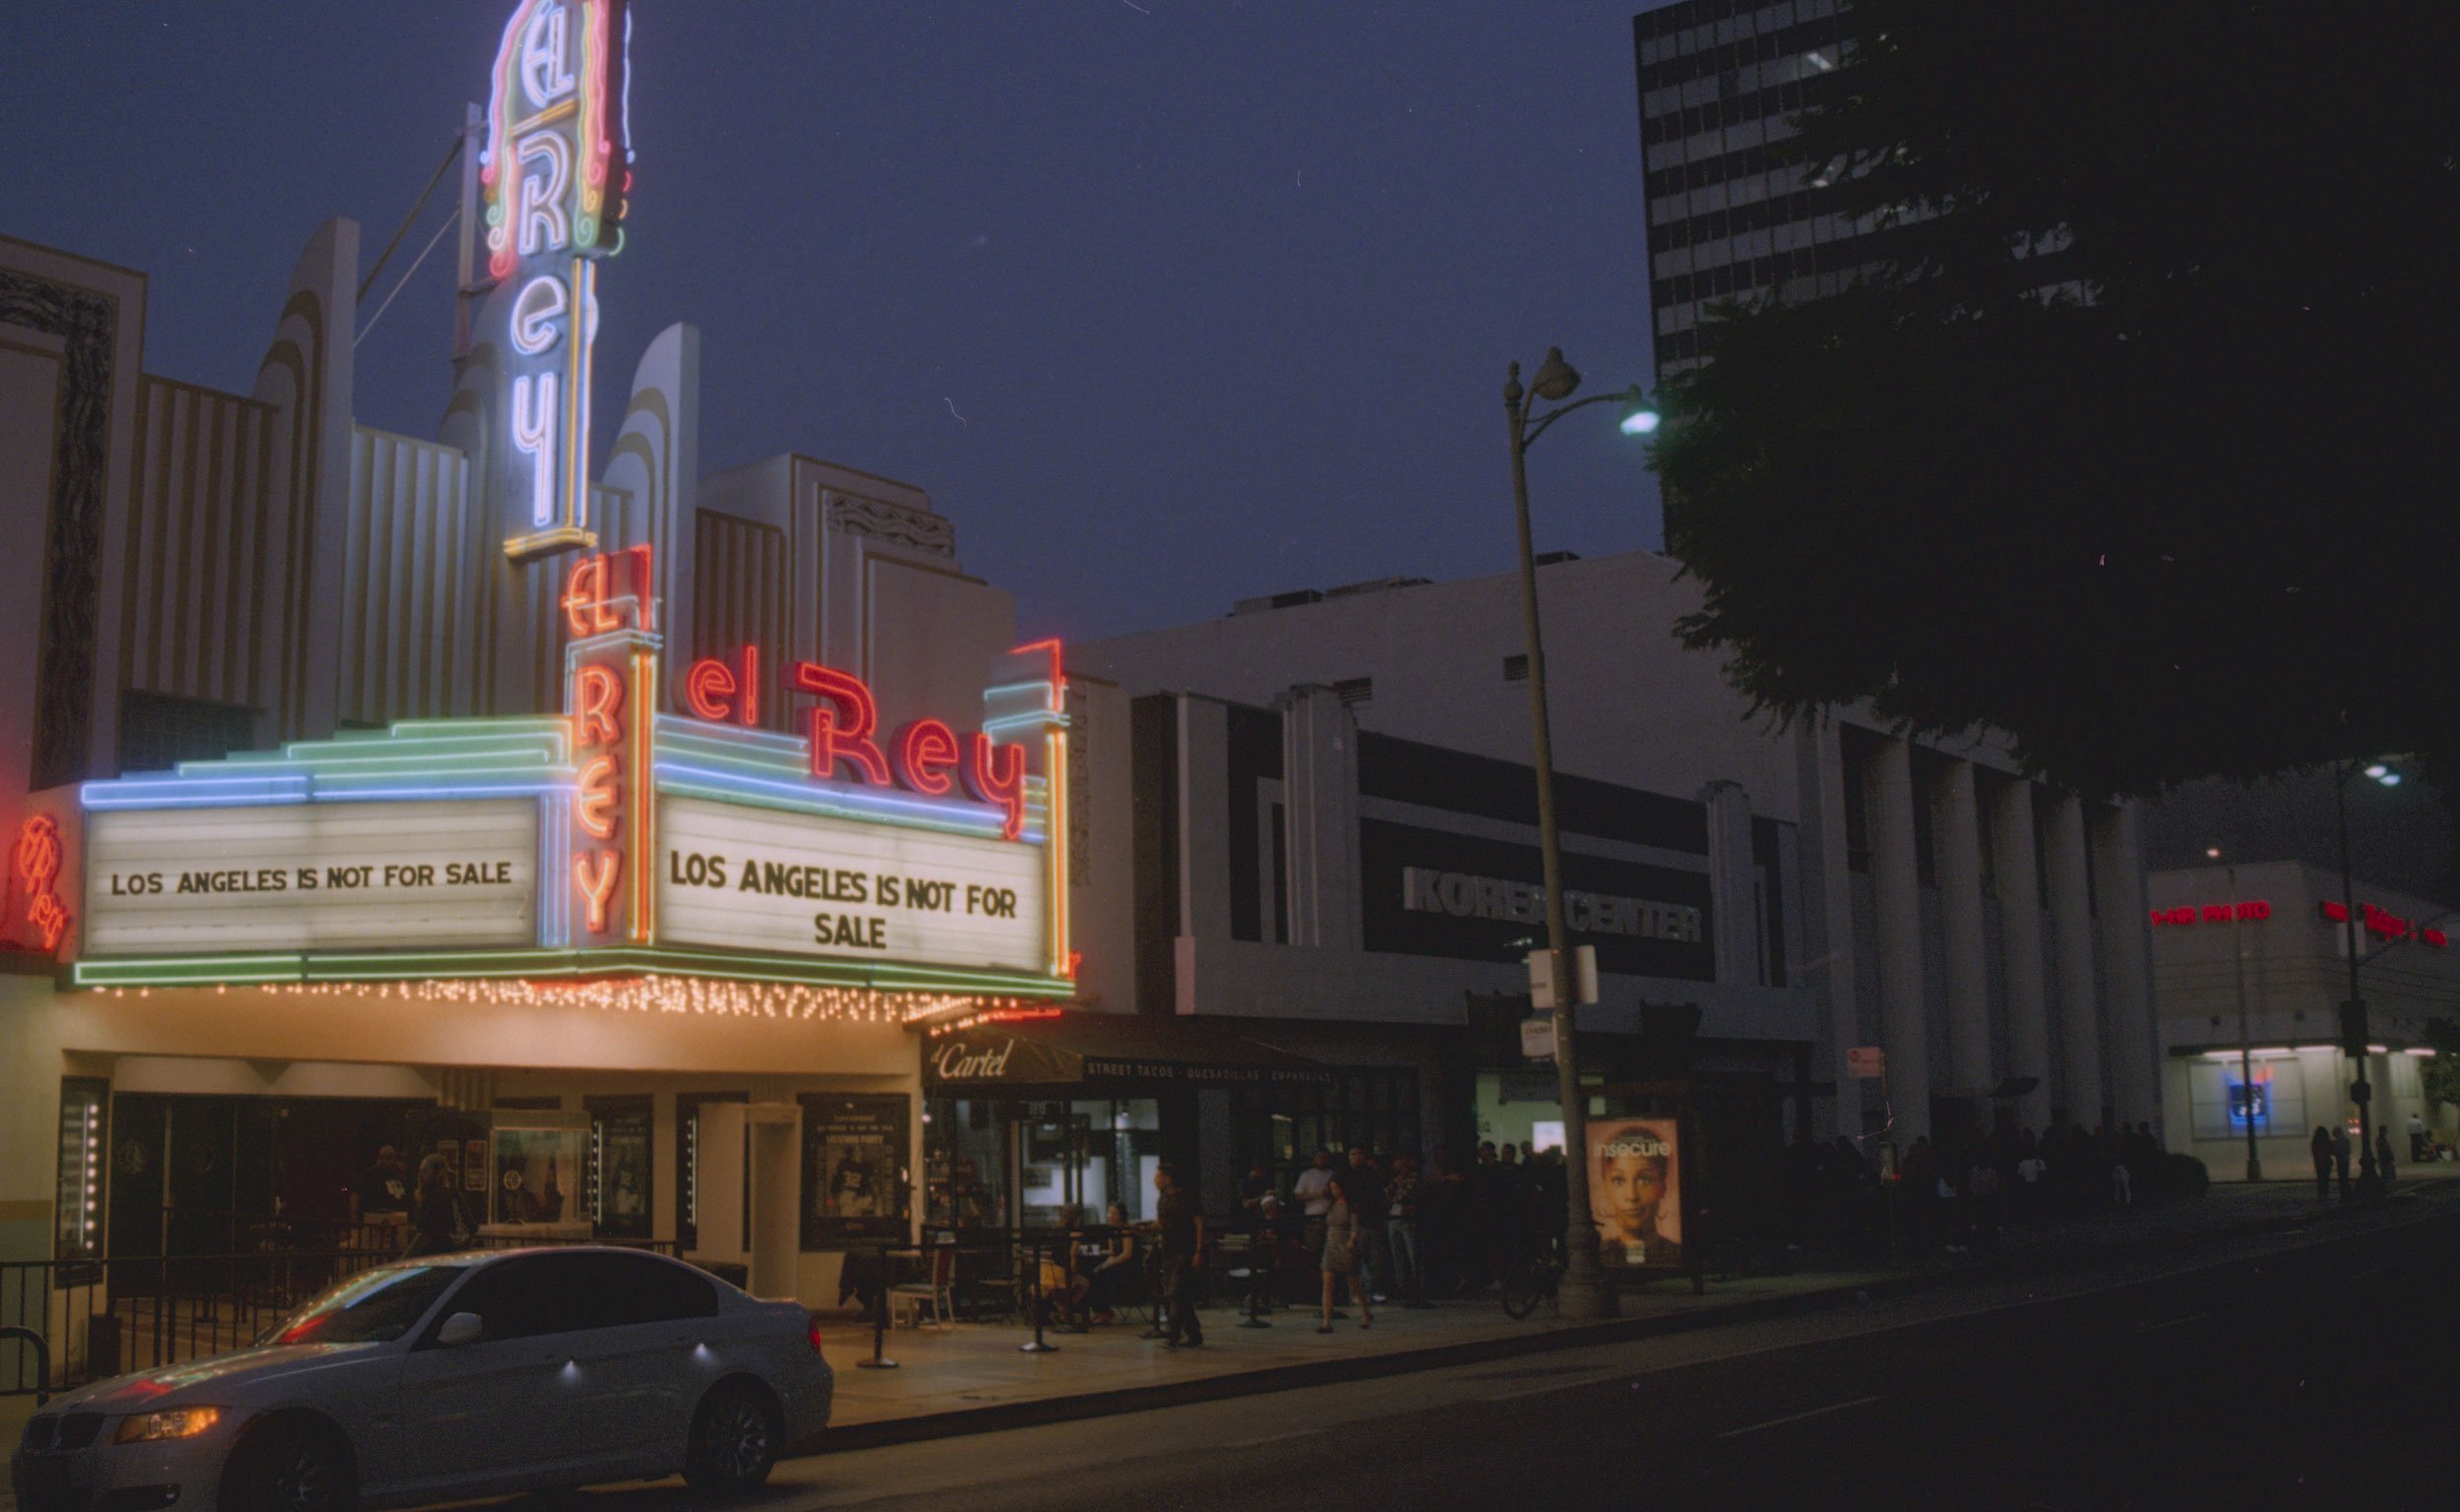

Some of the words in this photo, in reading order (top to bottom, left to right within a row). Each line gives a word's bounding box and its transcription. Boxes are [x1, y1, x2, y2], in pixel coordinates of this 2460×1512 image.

[787, 661, 1026, 842] Rey
[111, 873, 163, 895] LOS
[177, 869, 287, 894] ANGELES
[296, 868, 319, 889] IS
[327, 866, 373, 889] NOT
[384, 864, 435, 887] FOR
[446, 861, 512, 884] SALE
[670, 850, 726, 889] LOS
[739, 860, 867, 903] ANGELES
[877, 876, 899, 906] IS
[906, 878, 958, 913] NOT
[966, 885, 1017, 919] FOR
[814, 913, 887, 949] SALE
[1561, 889, 1702, 944] CENTER
[939, 1039, 1015, 1080] Cartel
[1087, 1062, 1131, 1076] STREET
[1138, 1064, 1174, 1079] TACOS
[1594, 1142, 1671, 1158] insecure
